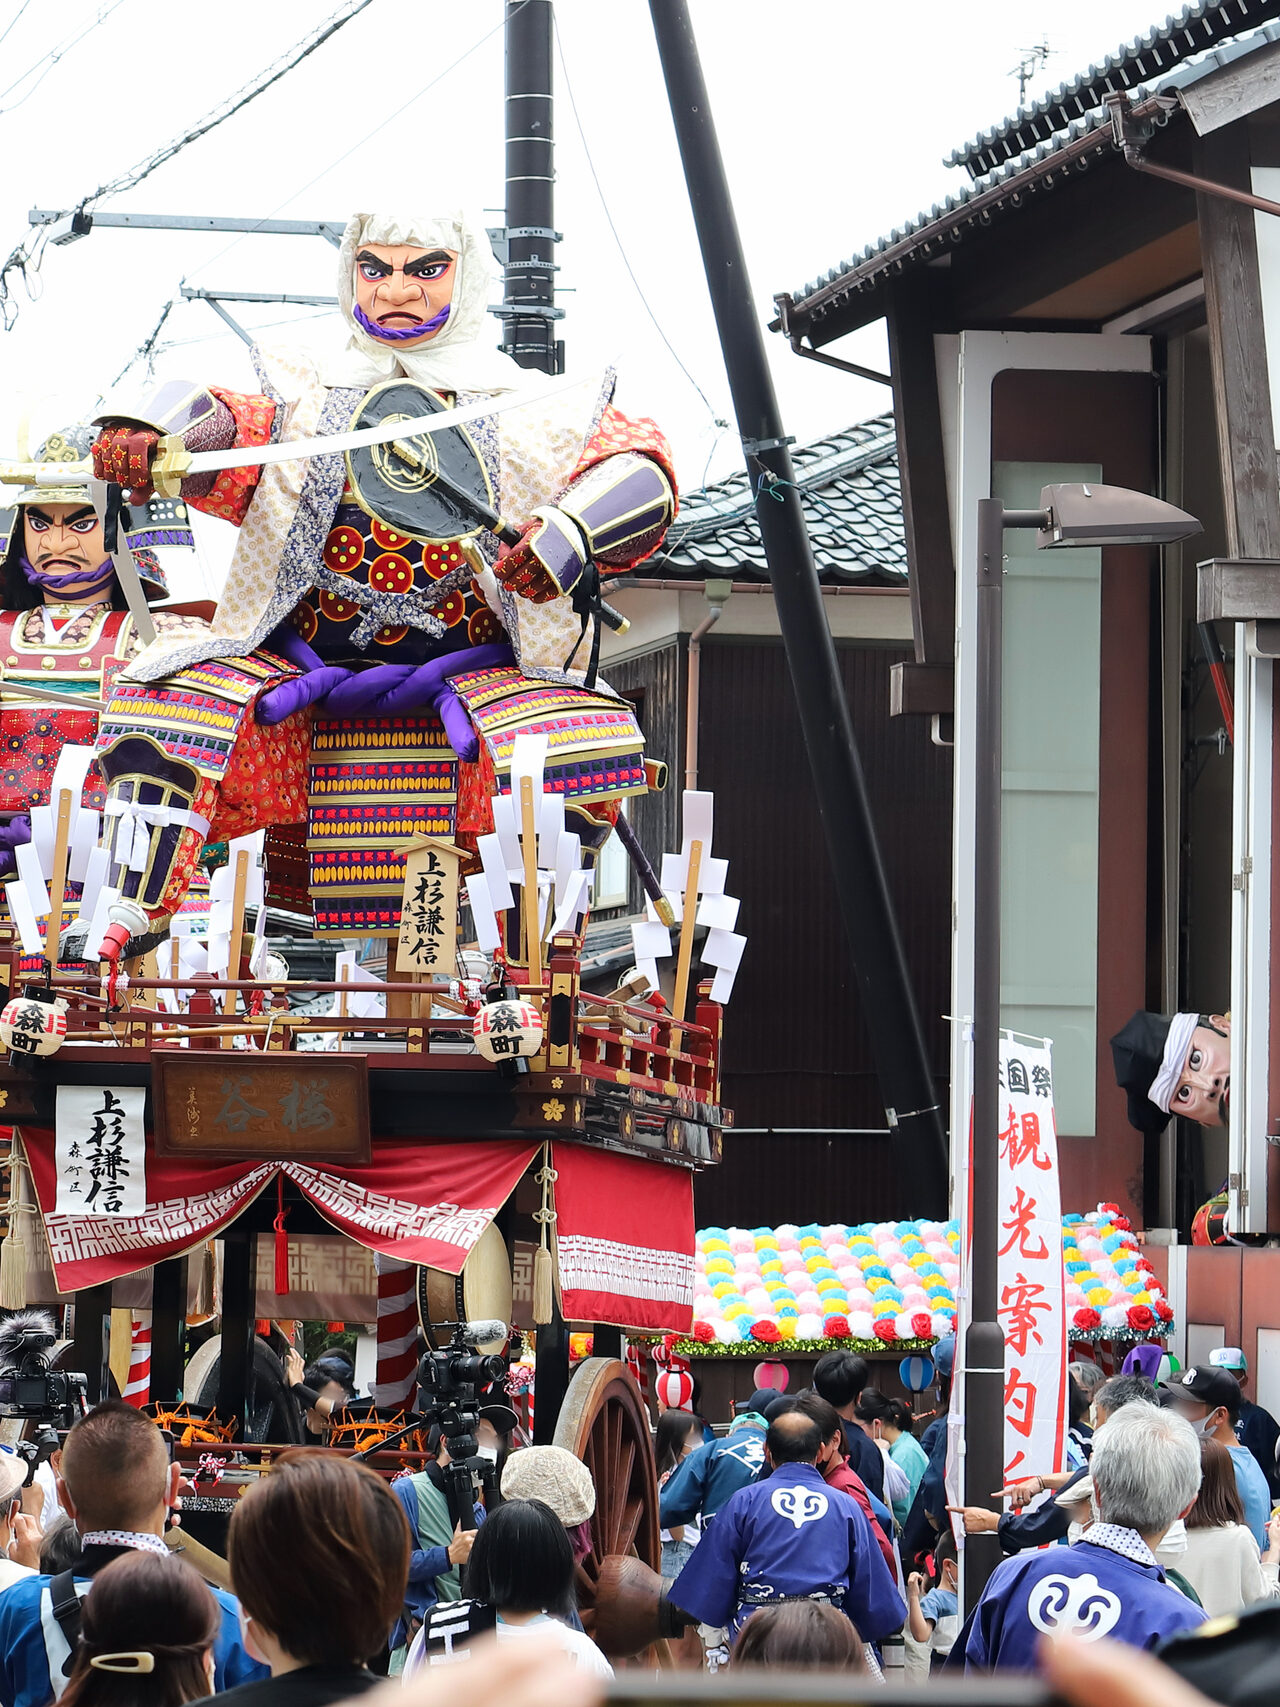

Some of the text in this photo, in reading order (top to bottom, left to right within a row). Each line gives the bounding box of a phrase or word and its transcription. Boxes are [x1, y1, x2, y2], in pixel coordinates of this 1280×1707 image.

[408, 851, 446, 965] 上杉謙信
[11, 1003, 45, 1054] 森町
[490, 1003, 524, 1055] 森町
[999, 1058, 1052, 1098] 国祭
[85, 1089, 130, 1213] 上杉謙信
